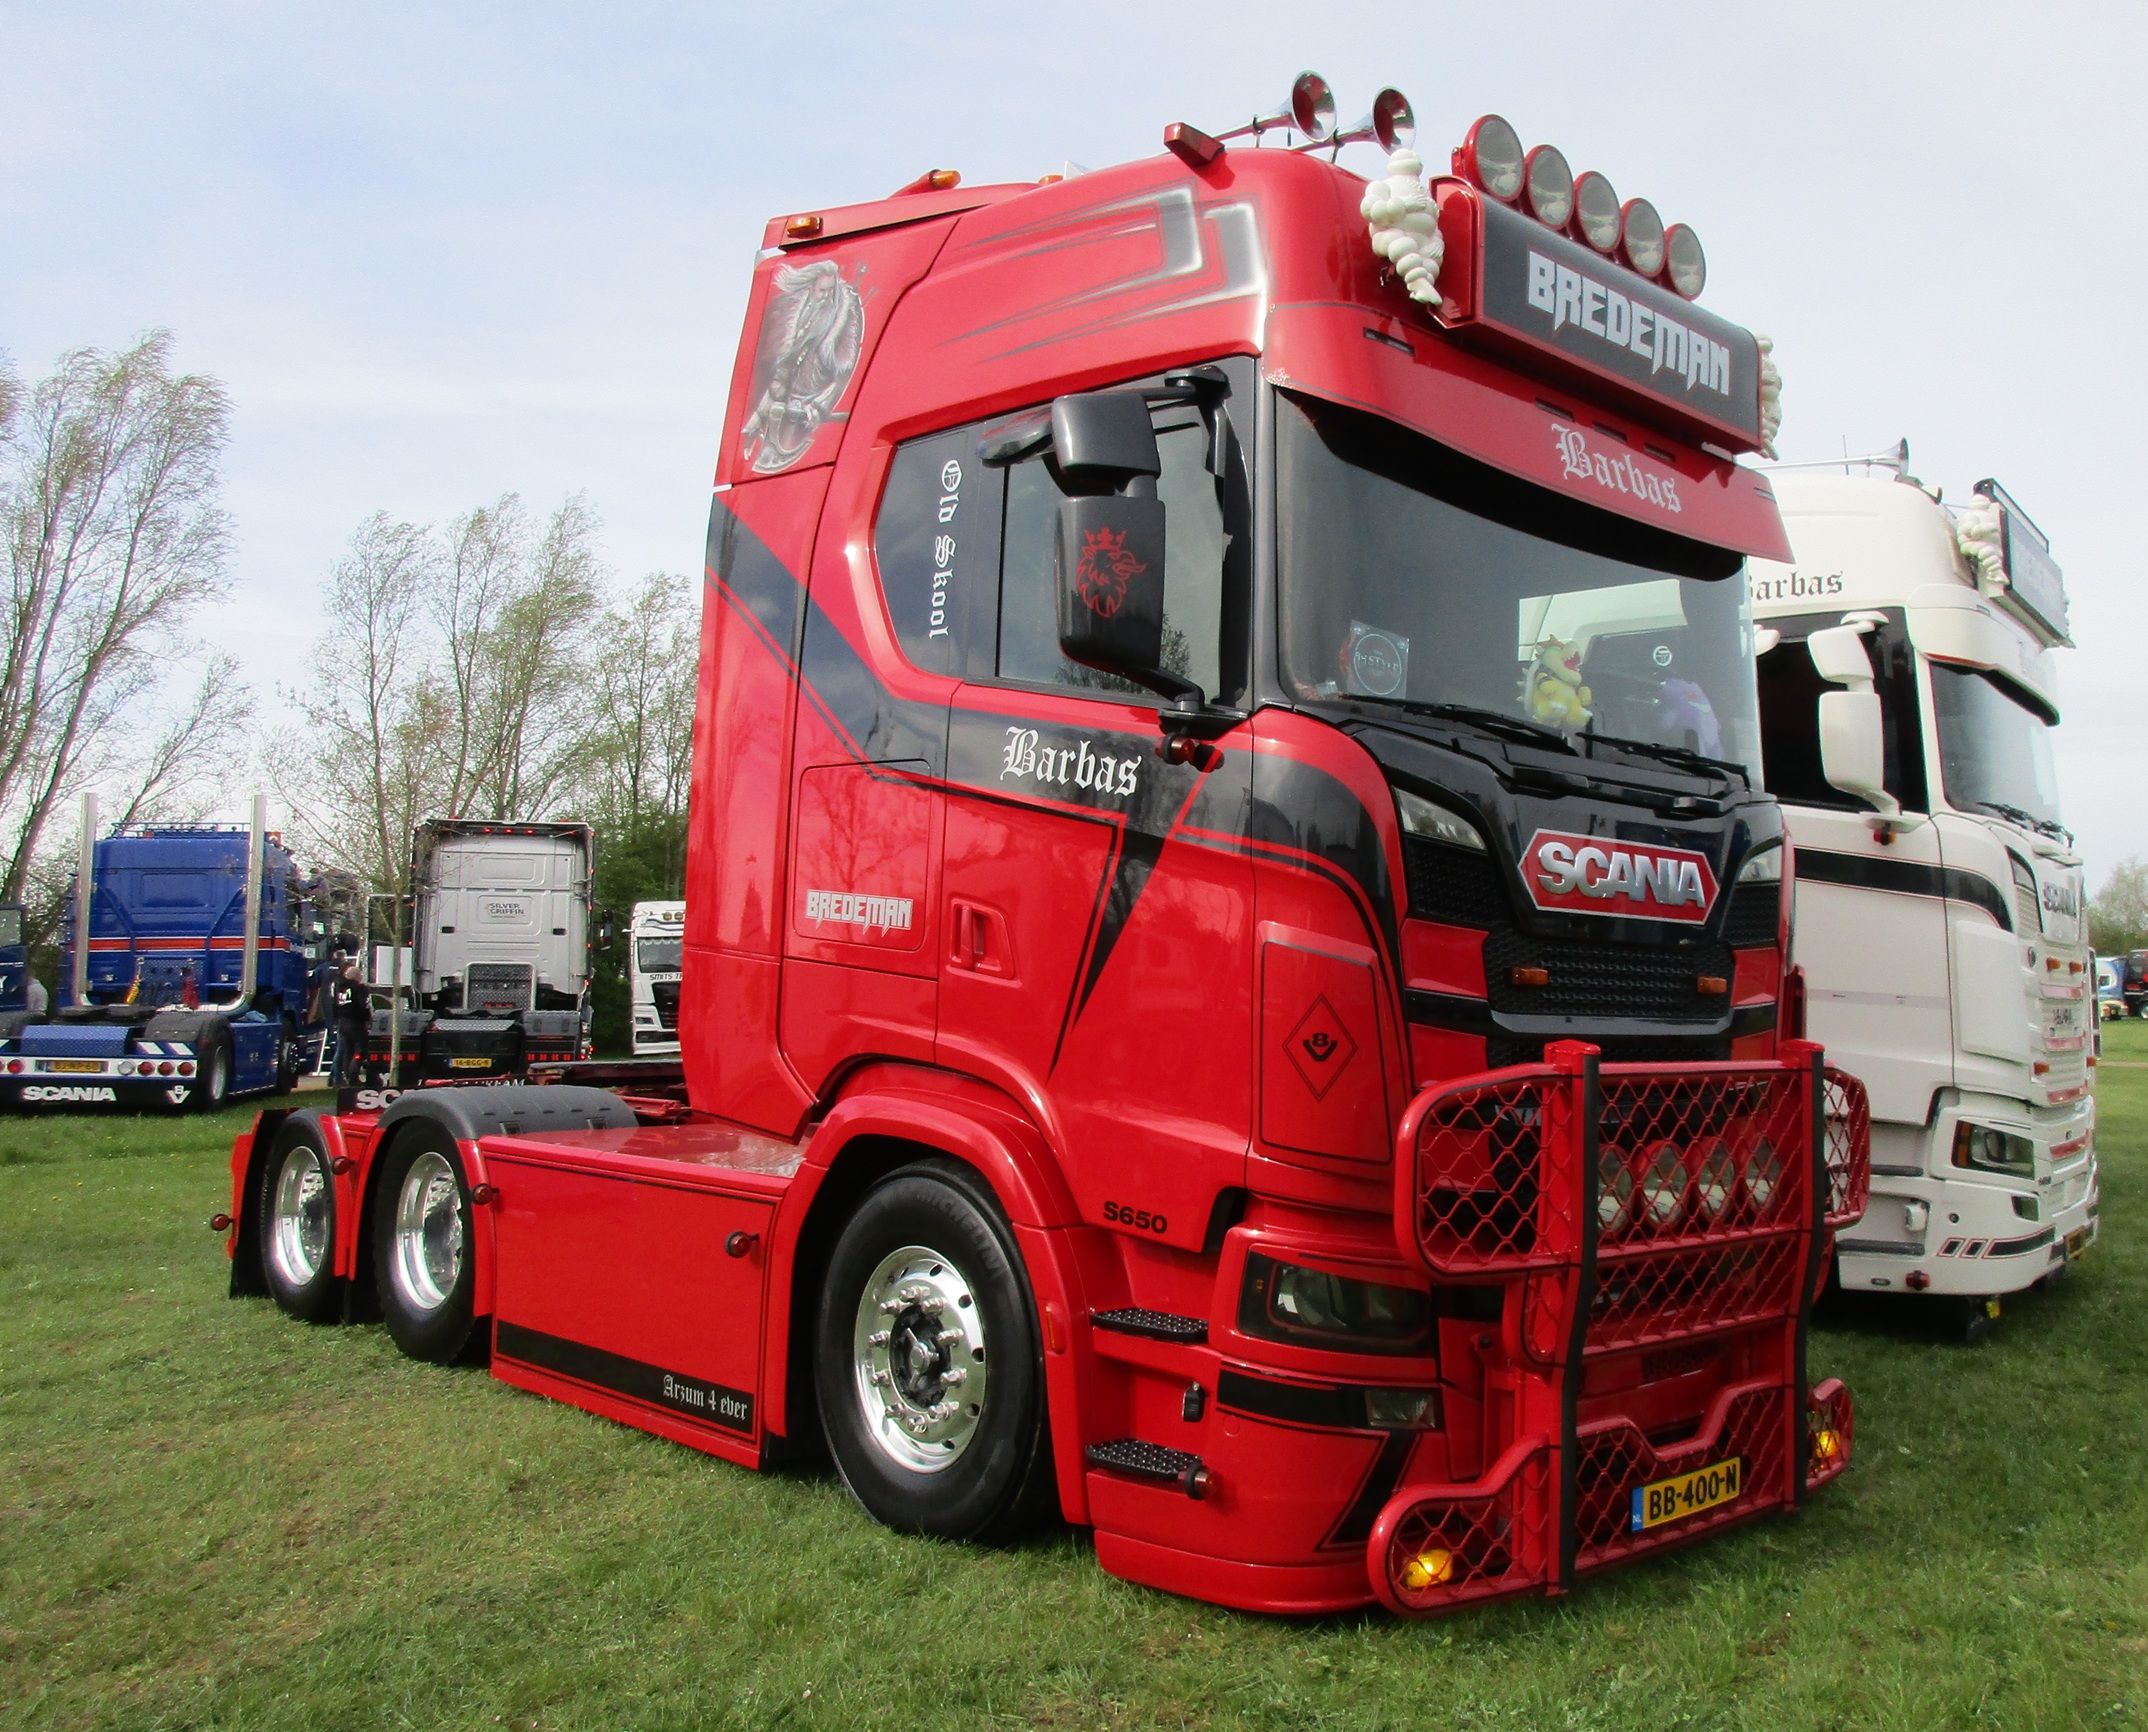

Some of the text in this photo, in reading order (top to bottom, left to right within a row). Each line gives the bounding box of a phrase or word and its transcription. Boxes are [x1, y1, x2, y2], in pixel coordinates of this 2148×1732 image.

[1528, 250, 1730, 396] BREDEMAN
[1551, 423, 1682, 513] Barbas
[929, 460, 962, 639] Old Skool
[1000, 726, 1142, 797] Barbas
[1537, 841, 1705, 909] SCANIA
[805, 889, 914, 937] BREDEMAN
[23, 1086, 117, 1101] SCANIA
[1104, 1200, 1168, 1234] S650
[663, 1374, 705, 1407] Arzum
[708, 1389, 717, 1411] 4
[1649, 1463, 1737, 1520] BB-400-N
